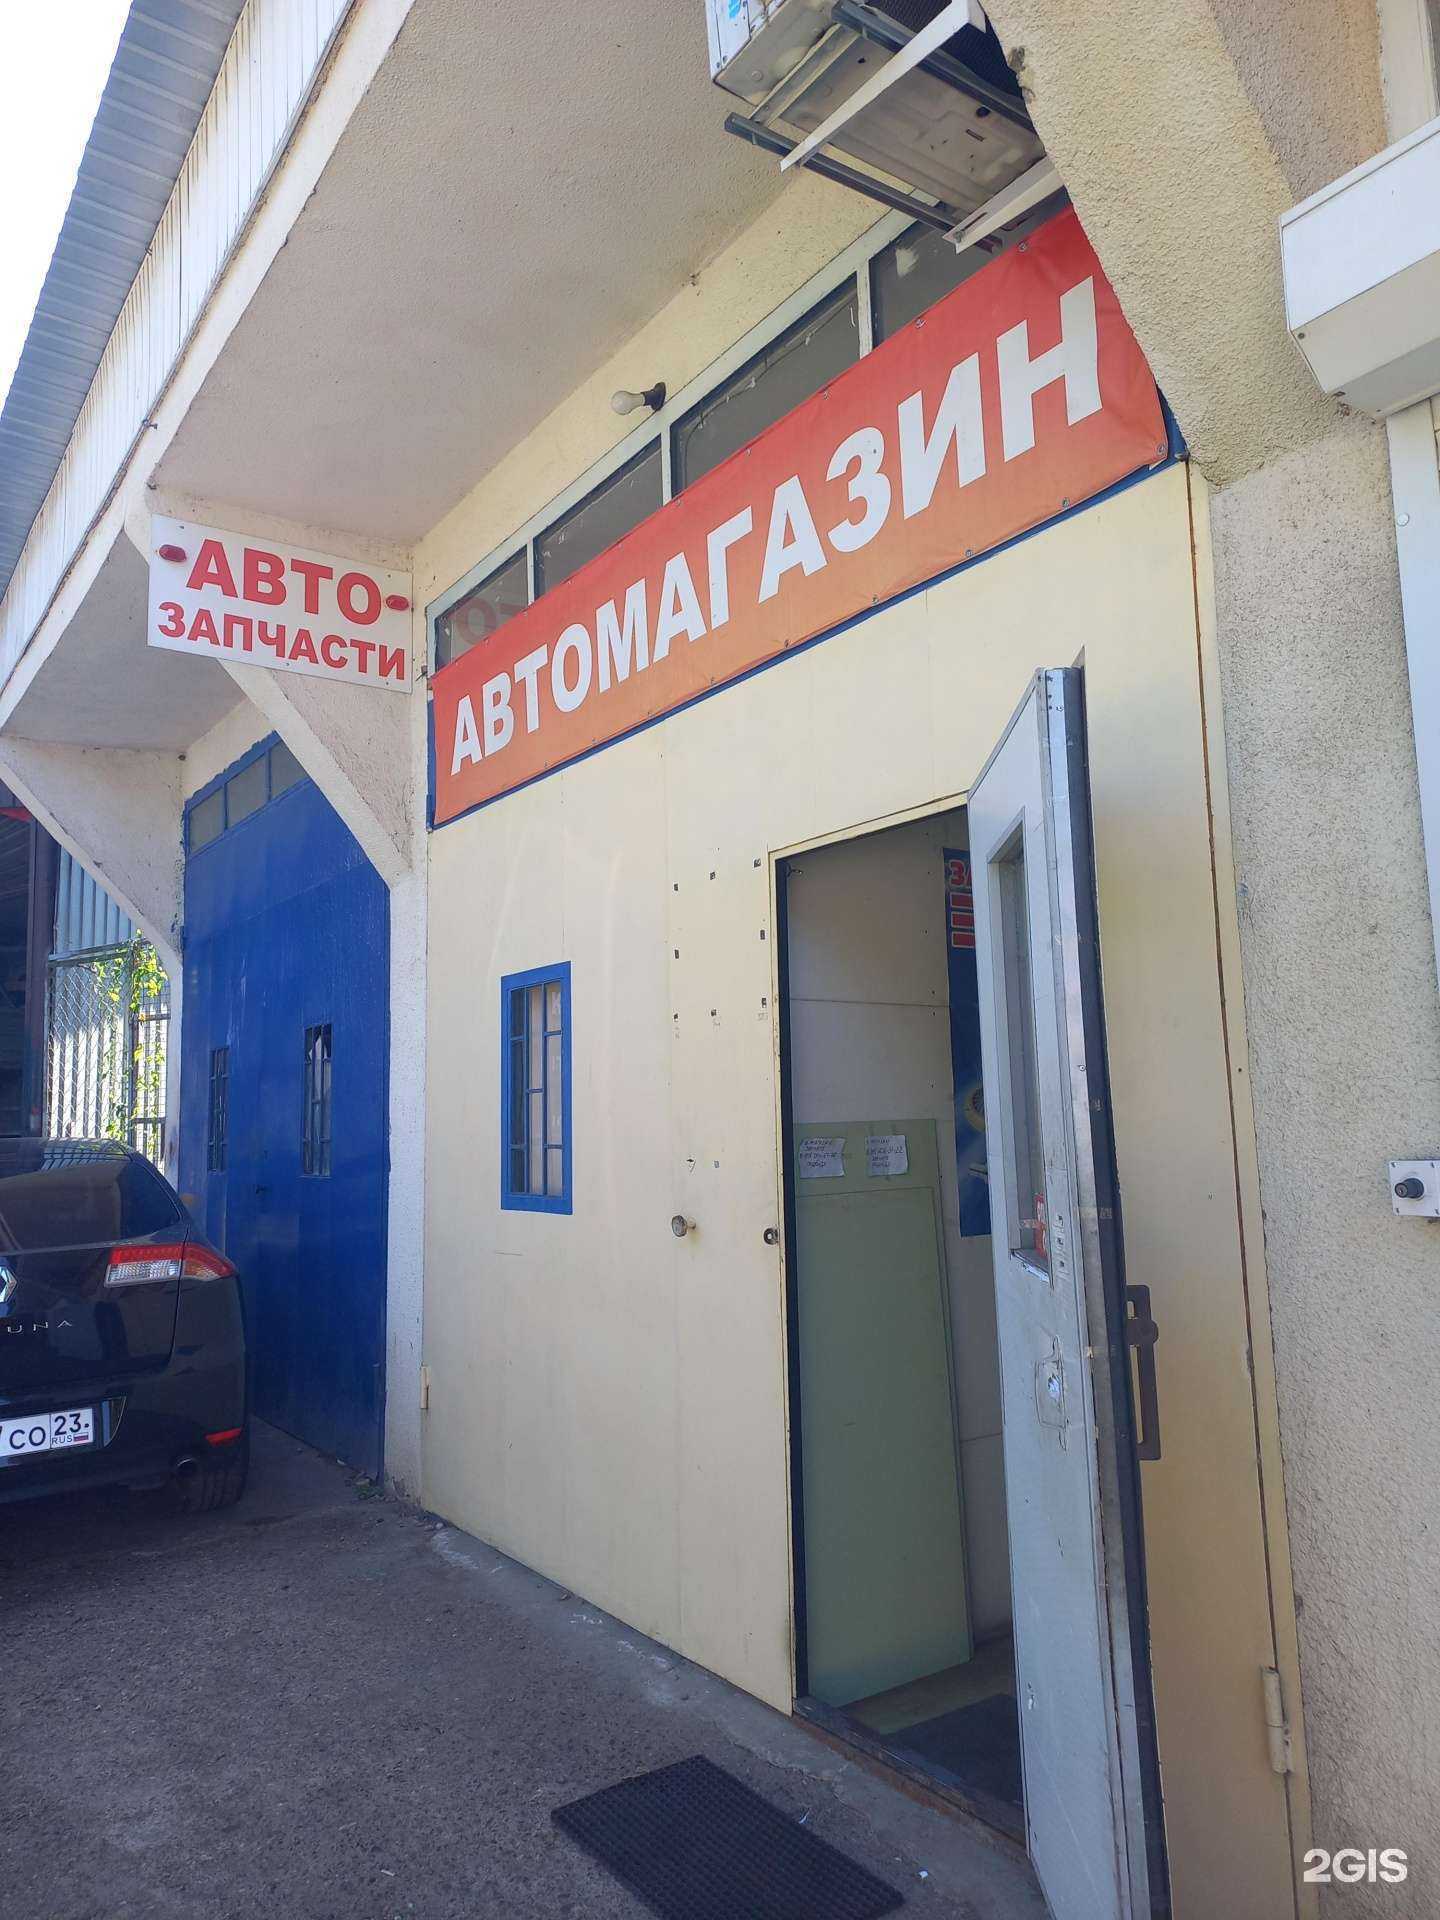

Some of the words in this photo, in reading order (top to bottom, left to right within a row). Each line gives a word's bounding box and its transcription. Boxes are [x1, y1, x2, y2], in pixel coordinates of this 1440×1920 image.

[450, 275, 1103, 776] АВТОМАГАЗИН
[186, 538, 382, 626] АВТО
[158, 601, 405, 681] ЗАПЧАСТИ
[0, 1425, 46, 1450] CO
[54, 1412, 82, 1436] 23
[51, 1434, 73, 1446] RUS
